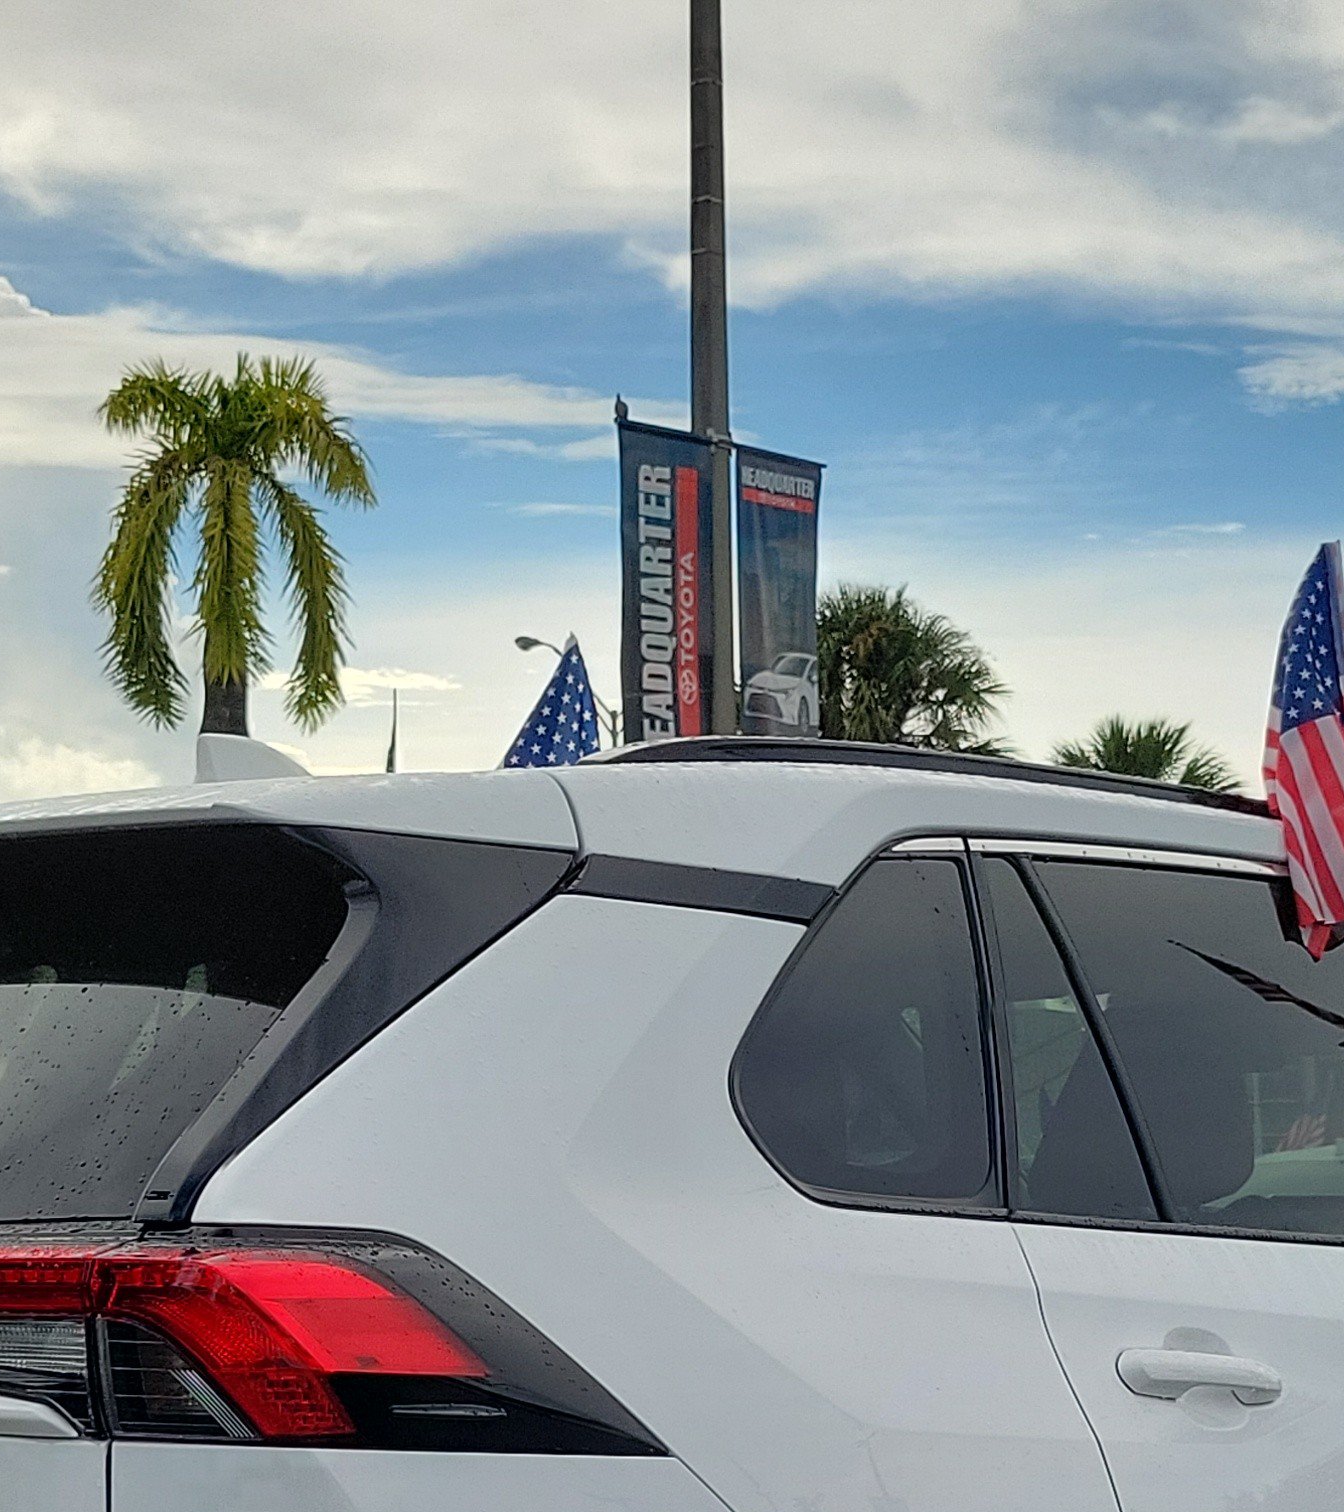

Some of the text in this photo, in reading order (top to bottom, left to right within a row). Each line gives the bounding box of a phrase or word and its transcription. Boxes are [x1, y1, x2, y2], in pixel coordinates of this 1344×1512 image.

[741, 465, 816, 499] HEADQUARTER
[638, 463, 675, 740] EADQUARTER
[679, 552, 696, 667] TOYOTA
